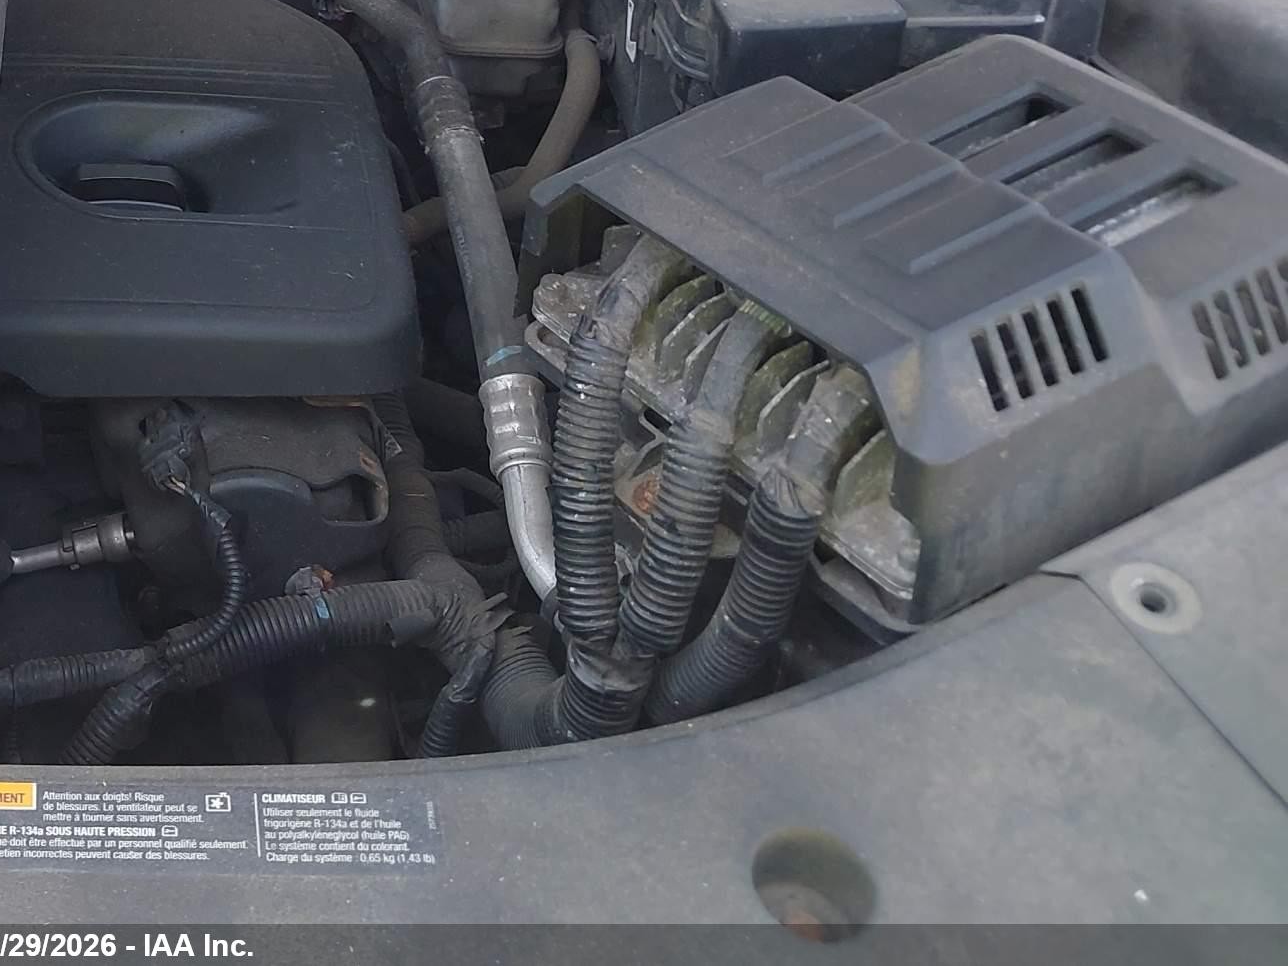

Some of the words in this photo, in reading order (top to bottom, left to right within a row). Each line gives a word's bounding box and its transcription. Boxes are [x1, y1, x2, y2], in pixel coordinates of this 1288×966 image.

[43, 791, 82, 801] Attention
[84, 793, 100, 801] aux
[102, 792, 132, 803] doigts!
[134, 792, 165, 803] Risque
[262, 793, 326, 803] CLIMATISEUR
[43, 802, 54, 811] de
[103, 803, 114, 812] Le
[115, 803, 162, 812] ventilateur
[164, 803, 185, 813] peut
[262, 808, 293, 817] Utiliser
[295, 808, 342, 817] seulement
[354, 808, 380, 817] fluide
[43, 813, 72, 822] mettre
[82, 814, 114, 822] tourner
[116, 814, 137, 822] sans
[313, 818, 347, 828] R-134a
[349, 819, 359, 828] et
[361, 820, 372, 829] de
[9, 825, 44, 836] R-134a
[46, 826, 72, 836] SOUS
[74, 827, 106, 836] HAUTE
[107, 827, 156, 837] PRESSION
[9, 837, 27, 846] doit
[87, 840, 102, 849] par
[118, 839, 162, 849] personnel
[265, 841, 276, 850] Le
[318, 842, 355, 851] contient
[357, 842, 369, 851] du
[23, 848, 73, 858] incorrectes
[75, 850, 111, 860] peuvent
[112, 851, 143, 859] causer
[145, 850, 162, 859] des
[266, 852, 298, 863] Charge
[300, 853, 312, 862] du
[383, 853, 395, 864] kg
[423, 853, 436, 864] lb)
